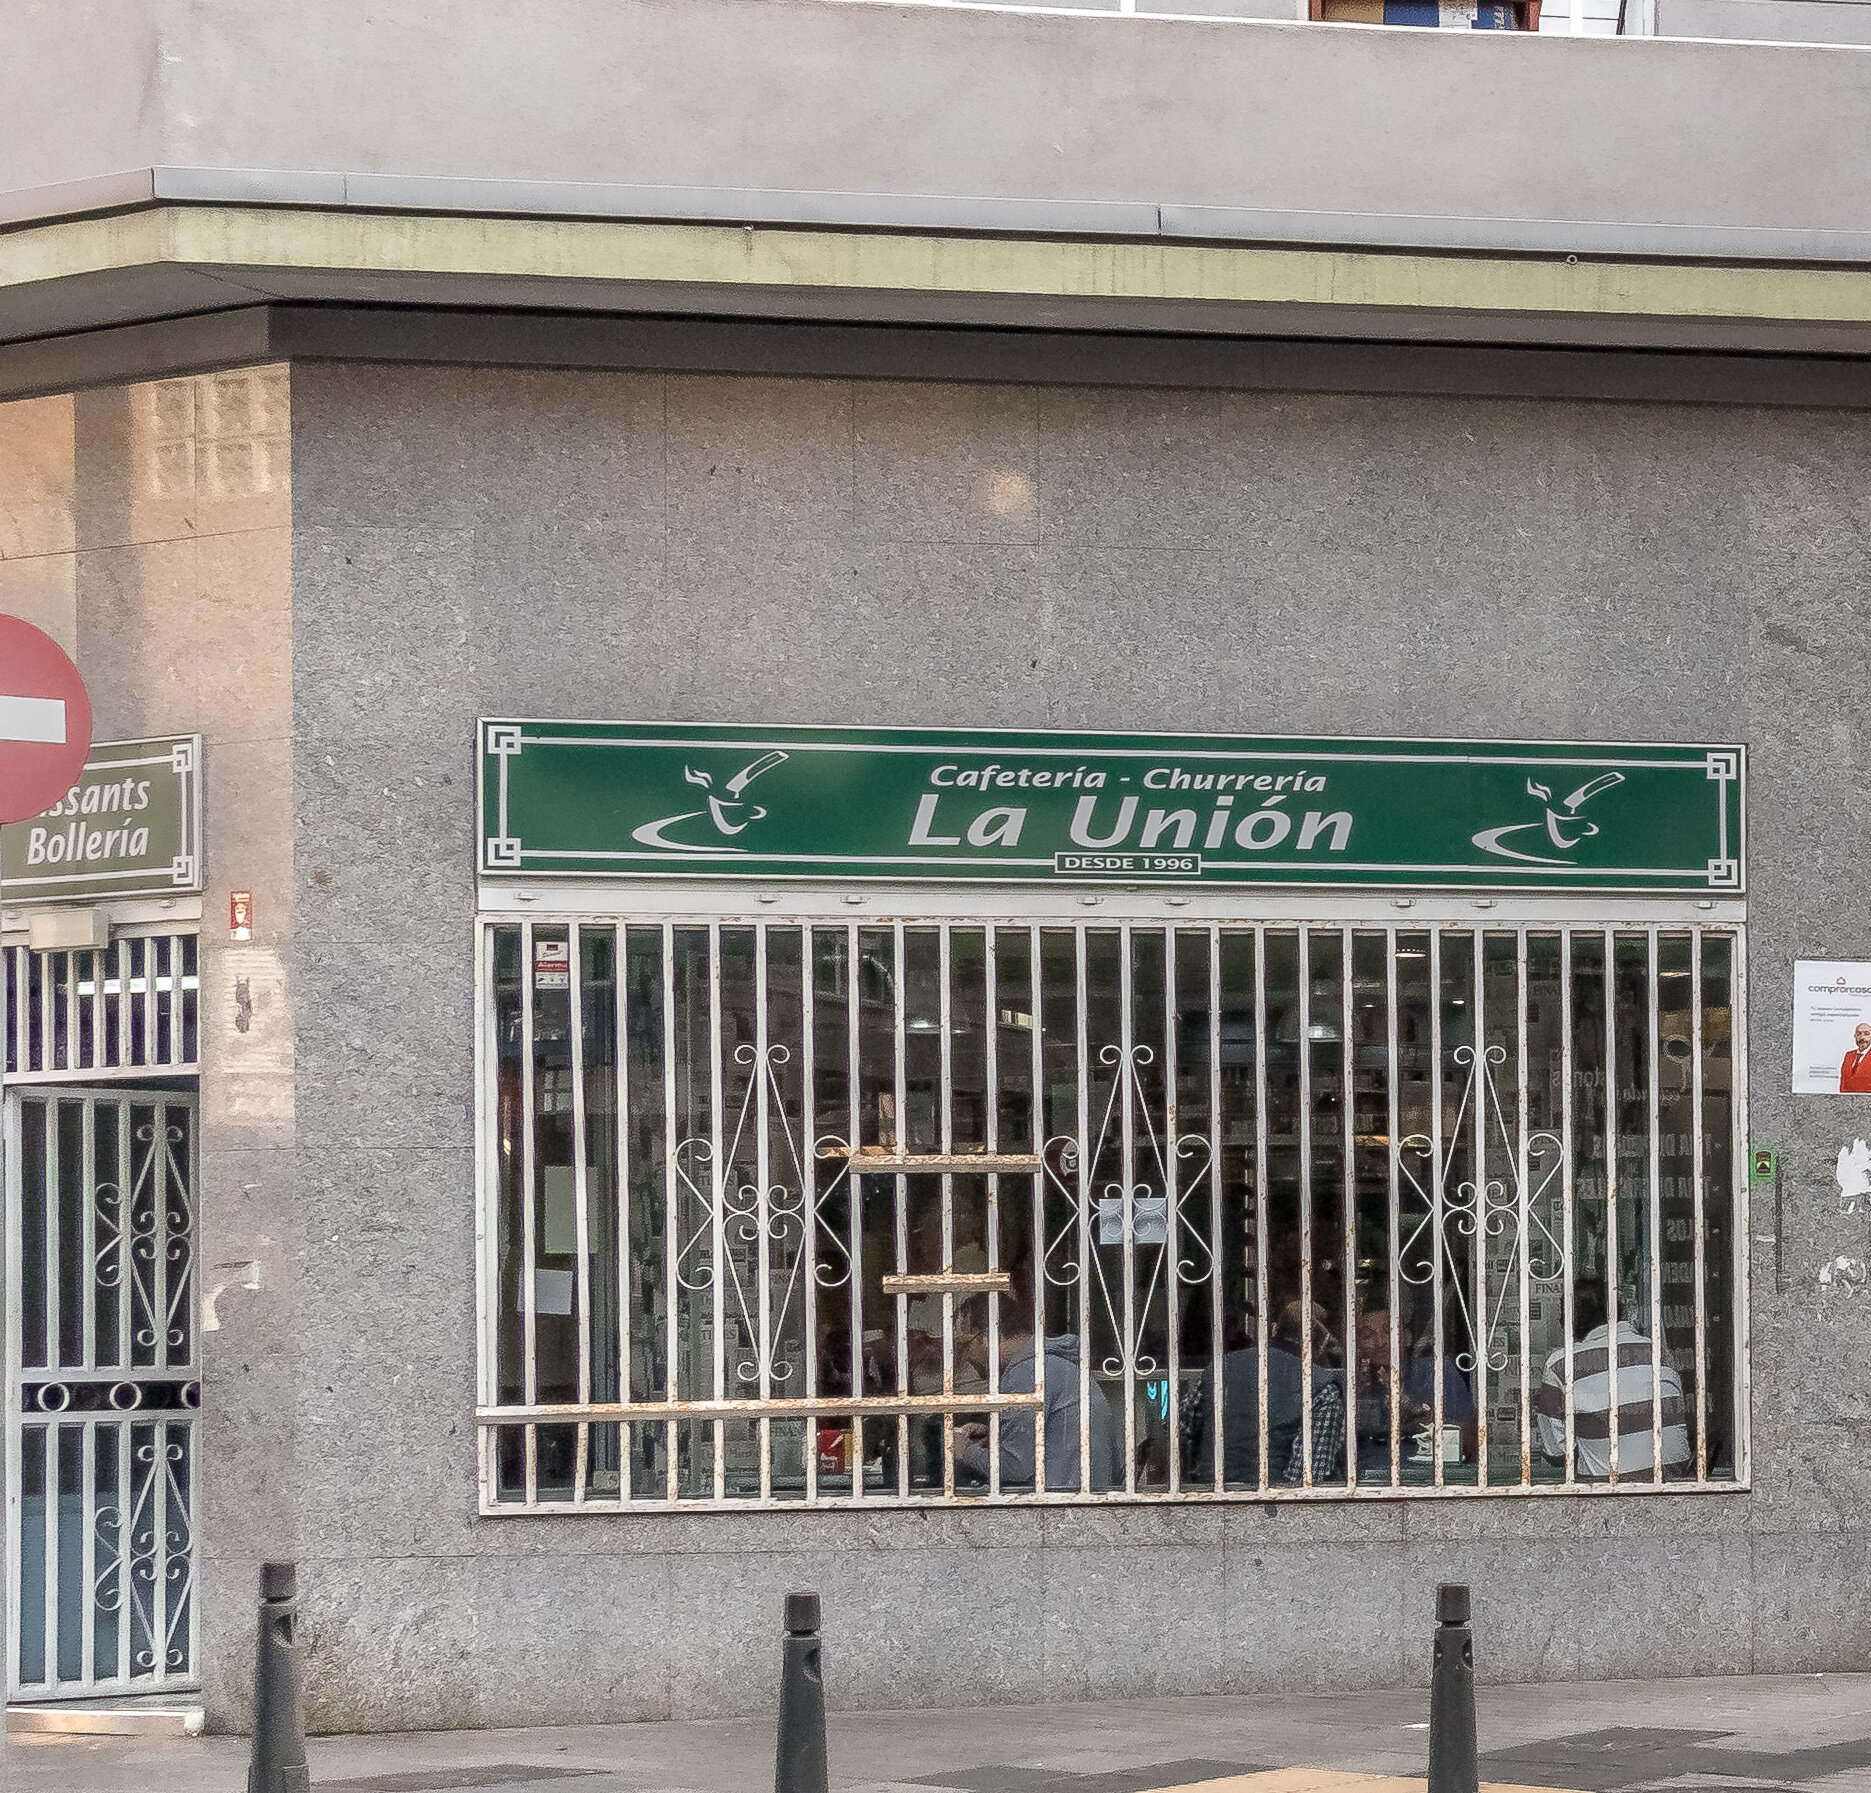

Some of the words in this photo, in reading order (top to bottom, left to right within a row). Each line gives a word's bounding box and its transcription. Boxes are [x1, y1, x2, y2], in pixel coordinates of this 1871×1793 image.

[39, 777, 151, 818] ssants
[929, 764, 1108, 792] Cafetería
[1142, 766, 1328, 792] Churrería
[26, 817, 150, 866] Bollería
[908, 793, 1028, 848] La
[1069, 794, 1355, 851] Unión
[1064, 856, 1135, 870] DESDE
[1142, 856, 1194, 870] 1996
